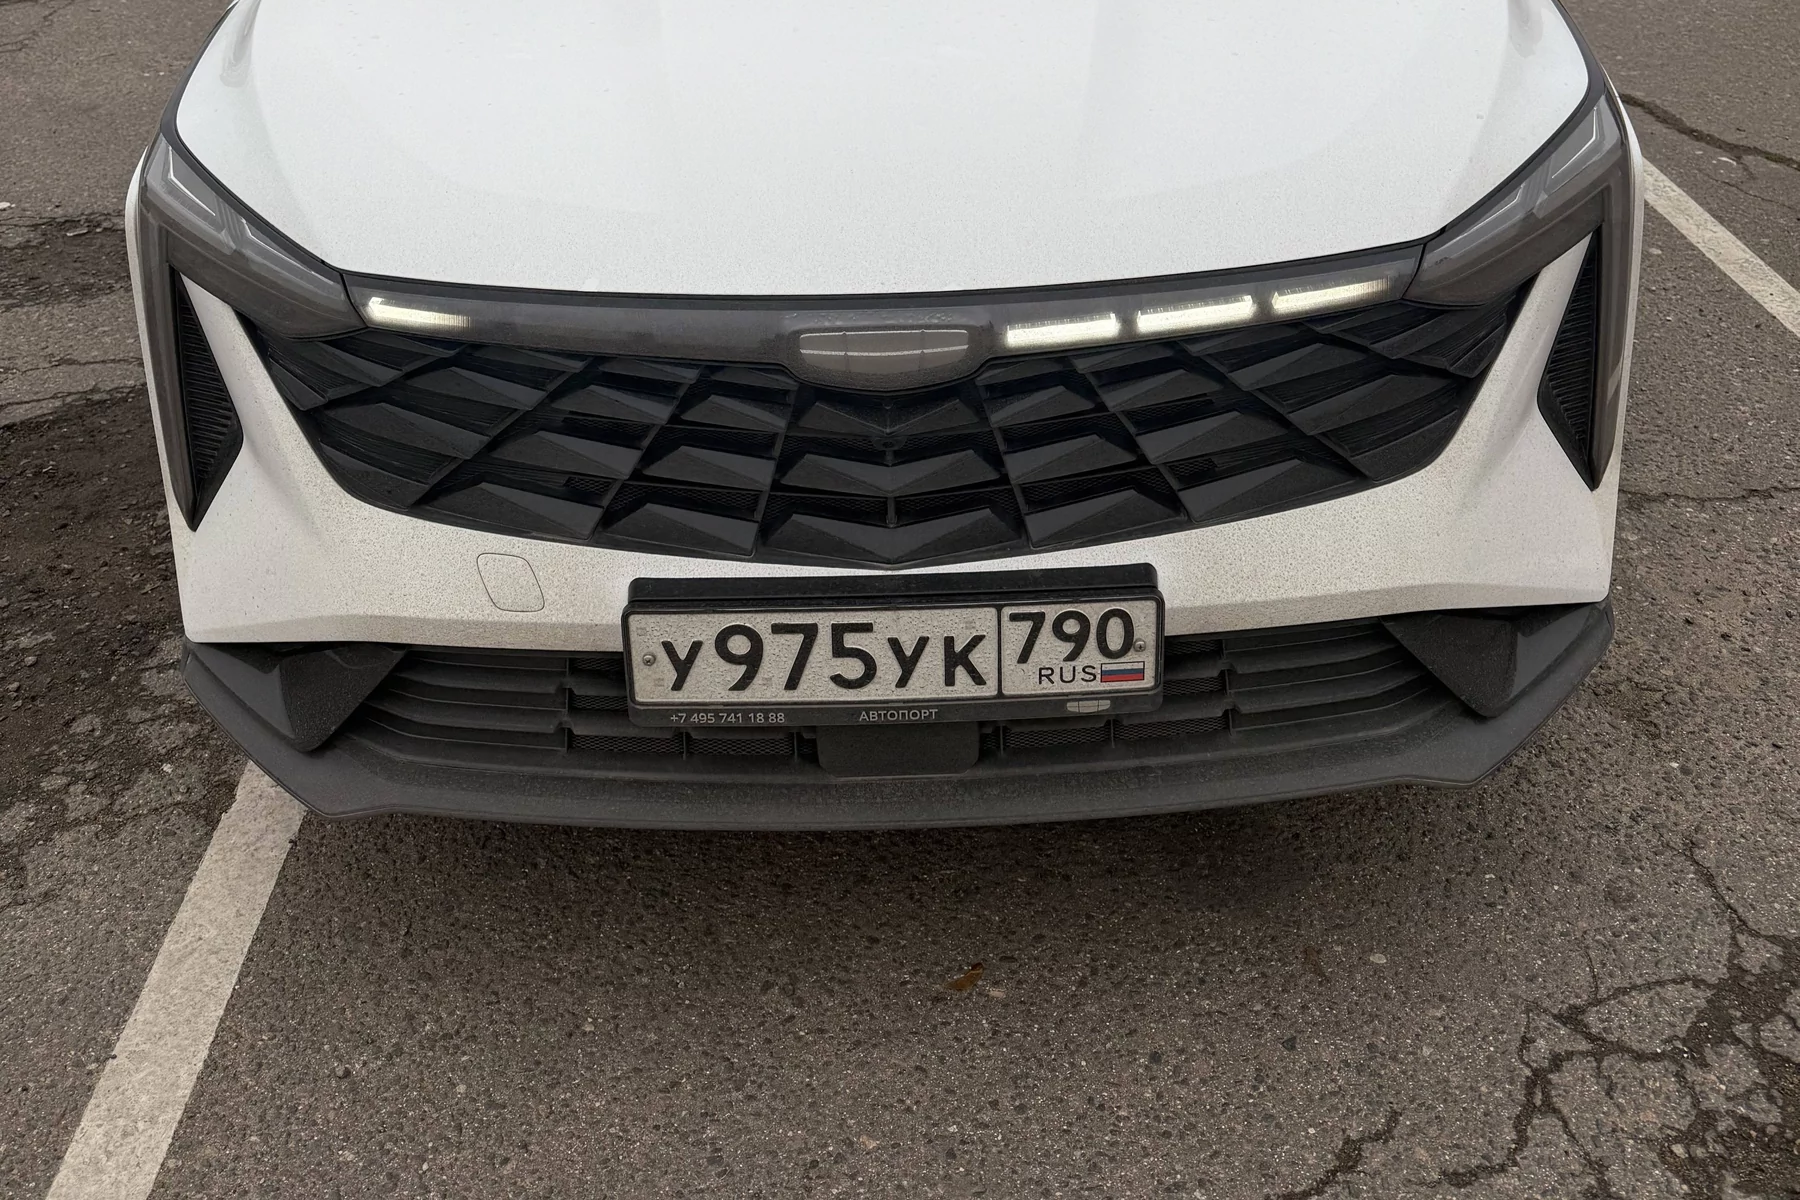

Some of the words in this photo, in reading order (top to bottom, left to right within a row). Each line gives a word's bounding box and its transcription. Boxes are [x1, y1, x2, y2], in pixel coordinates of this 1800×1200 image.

[1009, 608, 1135, 664] 790
[1038, 664, 1096, 685] RUS
[670, 713, 686, 723] +7
[690, 713, 715, 723] 495
[719, 713, 742, 723] 741
[748, 712, 764, 723] 18
[768, 712, 785, 723] 88
[860, 709, 938, 721] АВТОПОРТ
